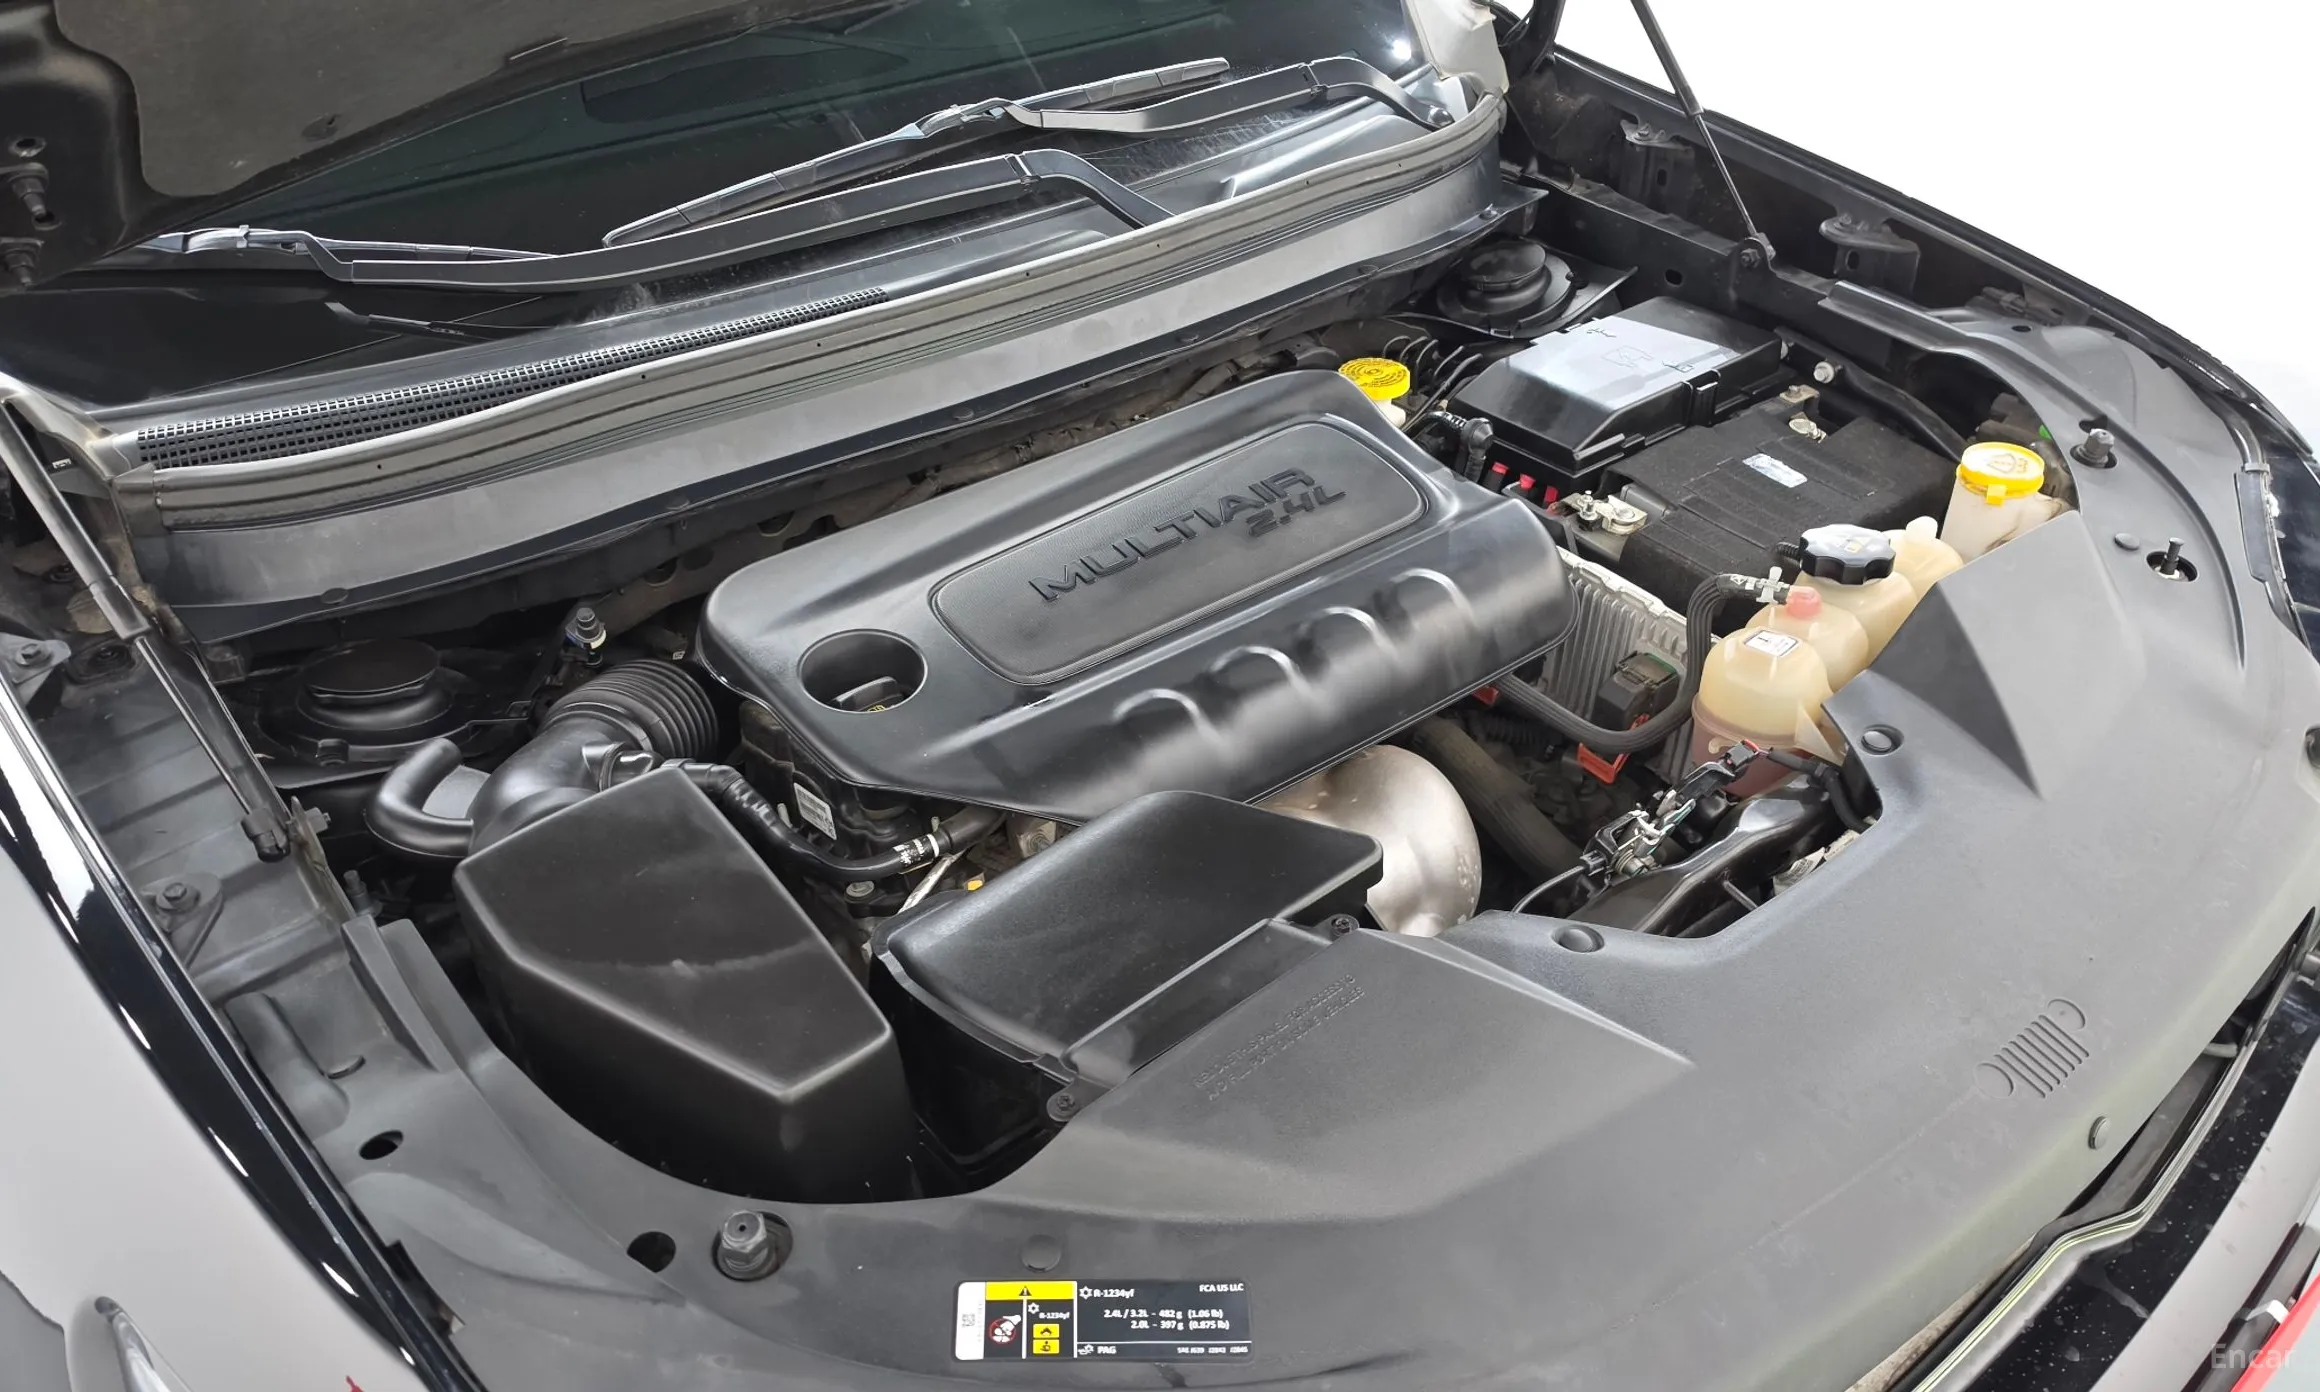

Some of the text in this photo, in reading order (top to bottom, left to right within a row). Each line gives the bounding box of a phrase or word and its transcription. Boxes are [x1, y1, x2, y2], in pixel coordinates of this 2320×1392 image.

[1246, 485, 1347, 538] 2.4L
[1028, 467, 1316, 603] MULTIAIR
[1199, 1282, 1244, 1292] FCA US LLC
[1093, 1288, 1135, 1299] R-1234yf
[1103, 1308, 1122, 1318] 2.4L
[1129, 1308, 1149, 1318] 3.2L
[1159, 1308, 1176, 1318] 482
[1130, 1319, 1150, 1329] 2.0L
[1160, 1320, 1177, 1329] 397
[1097, 1345, 1117, 1355] PAG
